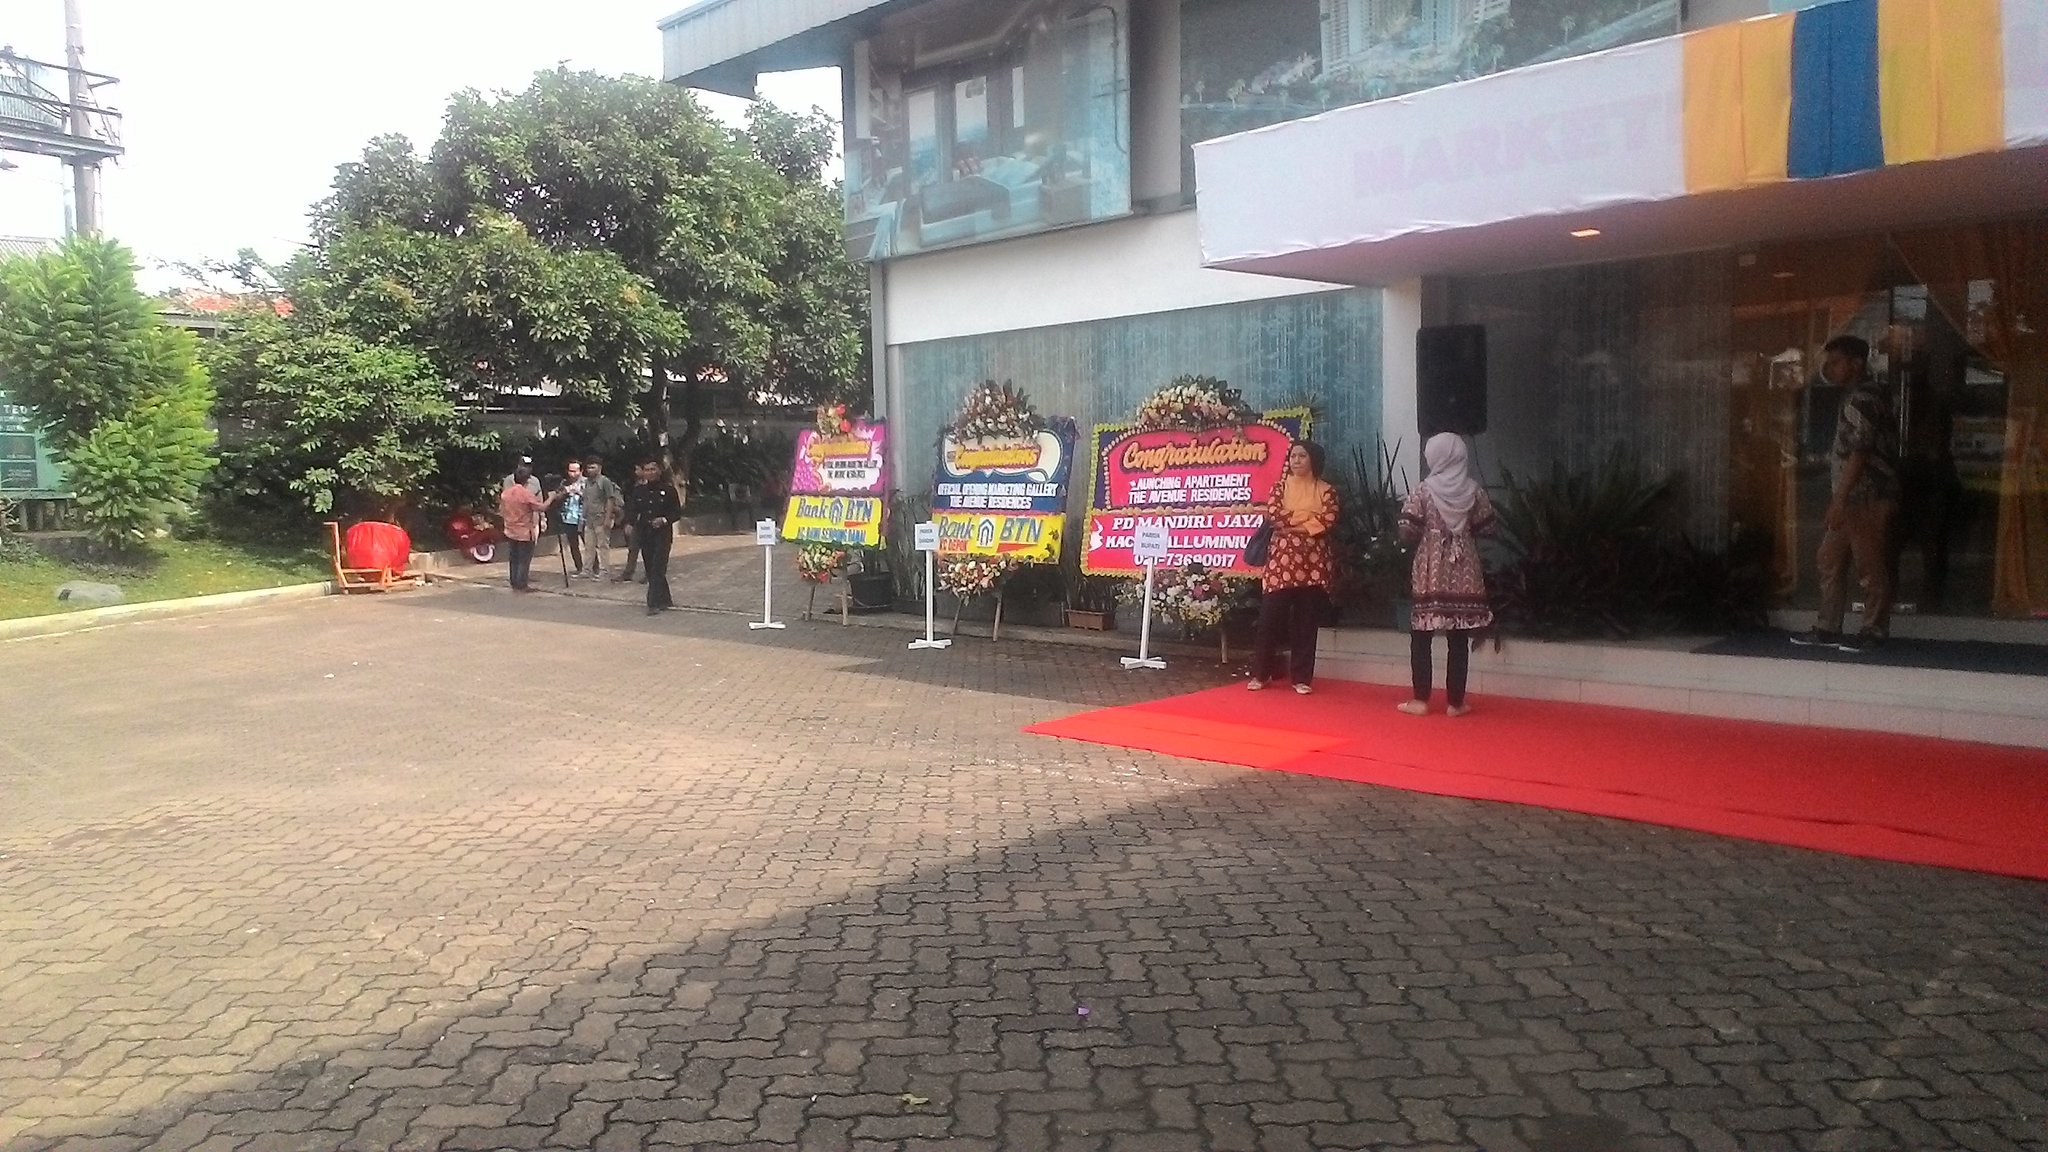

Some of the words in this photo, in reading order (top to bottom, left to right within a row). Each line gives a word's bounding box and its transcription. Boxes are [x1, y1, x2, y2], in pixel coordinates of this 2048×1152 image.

[1123, 437, 1268, 474] Congratulation
[1026, 482, 1058, 497] GALLERY
[1184, 474, 1251, 489] APARTEMENT
[1128, 490, 1147, 505] THE
[1148, 489, 1187, 504] AVENUE
[1190, 488, 1251, 503] RESIDENCES
[797, 498, 829, 518] Bank
[846, 498, 872, 521] BTN
[938, 516, 975, 539] Bank
[1000, 517, 1044, 542] BTN
[1112, 517, 1135, 530] PD
[1138, 514, 1214, 529] MANDIRI
[1217, 514, 1264, 528] JAYA
[1105, 535, 1135, 548] KAC
[1168, 535, 1251, 549] ALLUMINIU
